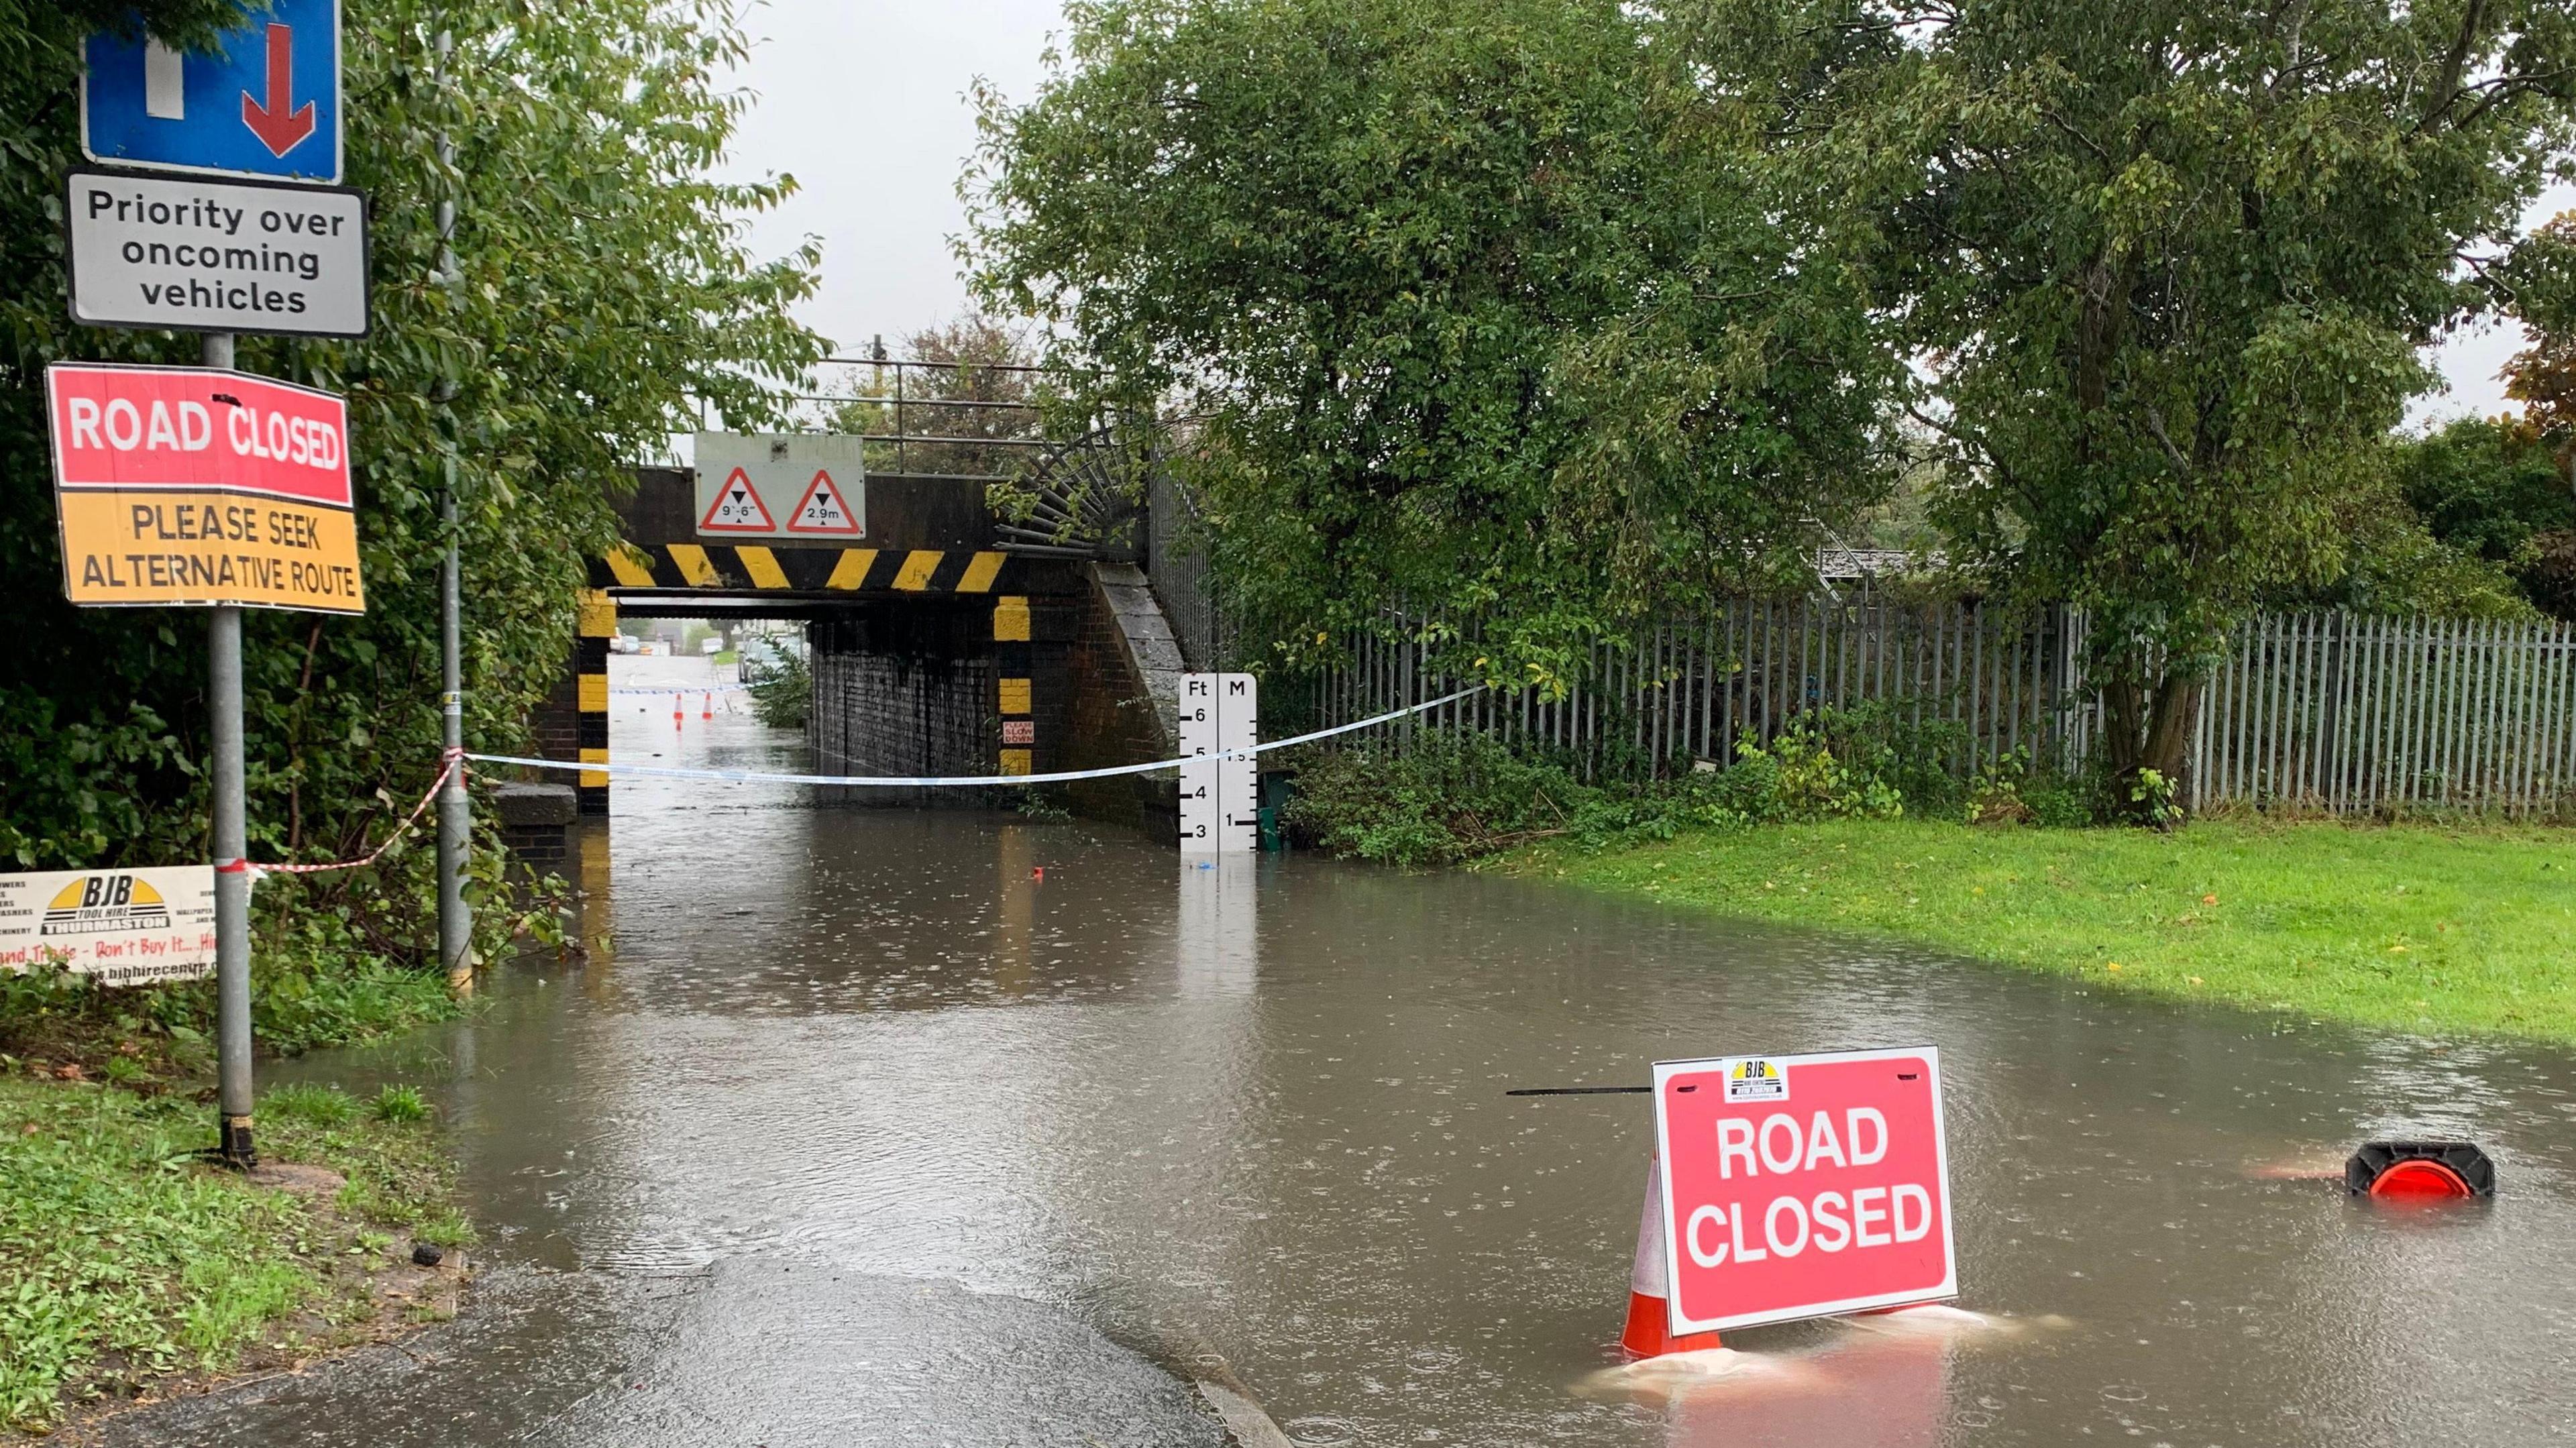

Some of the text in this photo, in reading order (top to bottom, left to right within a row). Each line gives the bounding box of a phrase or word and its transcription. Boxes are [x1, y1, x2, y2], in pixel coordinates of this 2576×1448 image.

[88, 190, 345, 237] Priority over
[122, 241, 319, 280] oncoming
[140, 279, 307, 314] vehicles
[68, 397, 340, 470] ROAD CLOSED
[807, 508, 839, 519] 2.9m
[131, 504, 321, 551] PLEASE SEEK
[82, 554, 356, 598] ALTERNATIVE ROUTE
[1189, 681, 1245, 696] Ft M
[1195, 709, 1205, 722] 6
[1195, 786, 1206, 799] 4
[1226, 814, 1232, 826] 1
[1196, 825, 1206, 838] 3
[83, 875, 133, 907] BJB
[78, 907, 129, 920] TOOL HIRE
[44, 916, 167, 935] THURMASTON
[95, 940, 136, 958] Don't
[140, 938, 167, 956] Buy
[1746, 1061, 1765, 1078] BJB
[1716, 1107, 1889, 1180] ROAD
[1686, 1183, 1933, 1268] CLOSED
